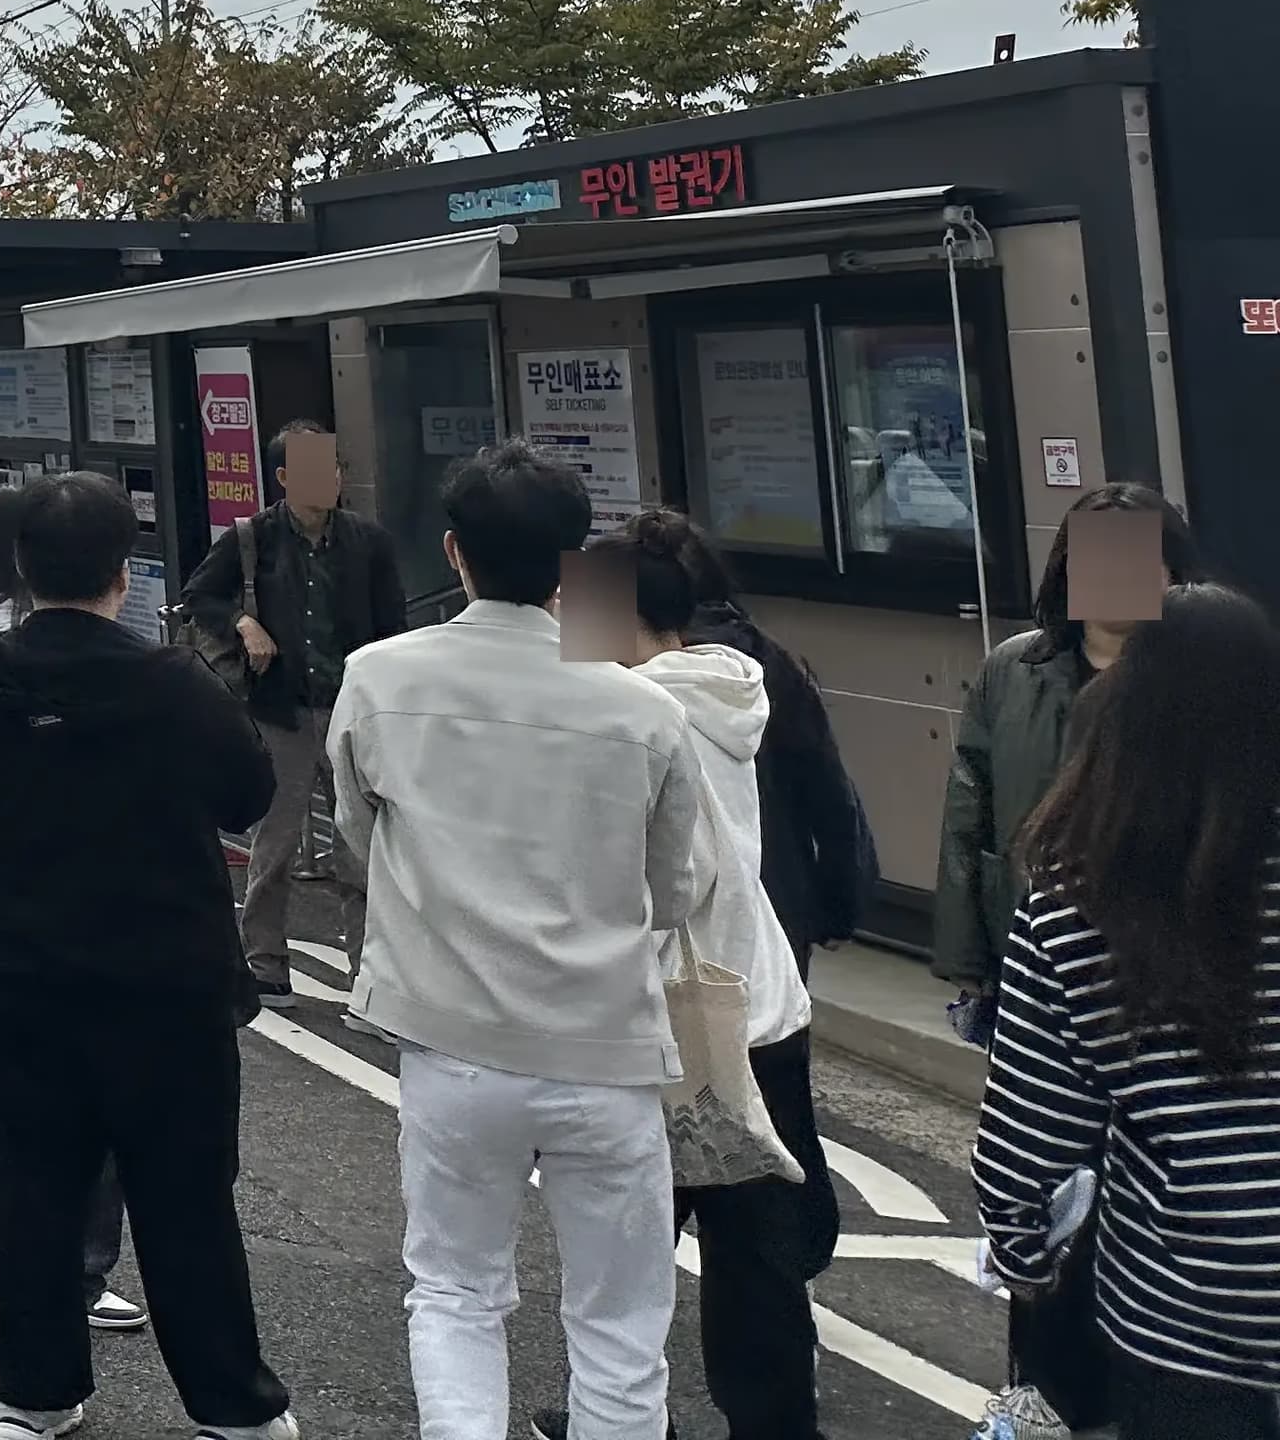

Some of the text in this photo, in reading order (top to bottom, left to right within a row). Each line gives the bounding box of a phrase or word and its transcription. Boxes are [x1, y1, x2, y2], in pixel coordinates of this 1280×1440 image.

[579, 145, 745, 220] 무인 발권기
[1240, 299, 1280, 334] 또
[527, 360, 623, 394] 무인매표소
[211, 401, 247, 424] 창구발권
[545, 398, 563, 411] SELF
